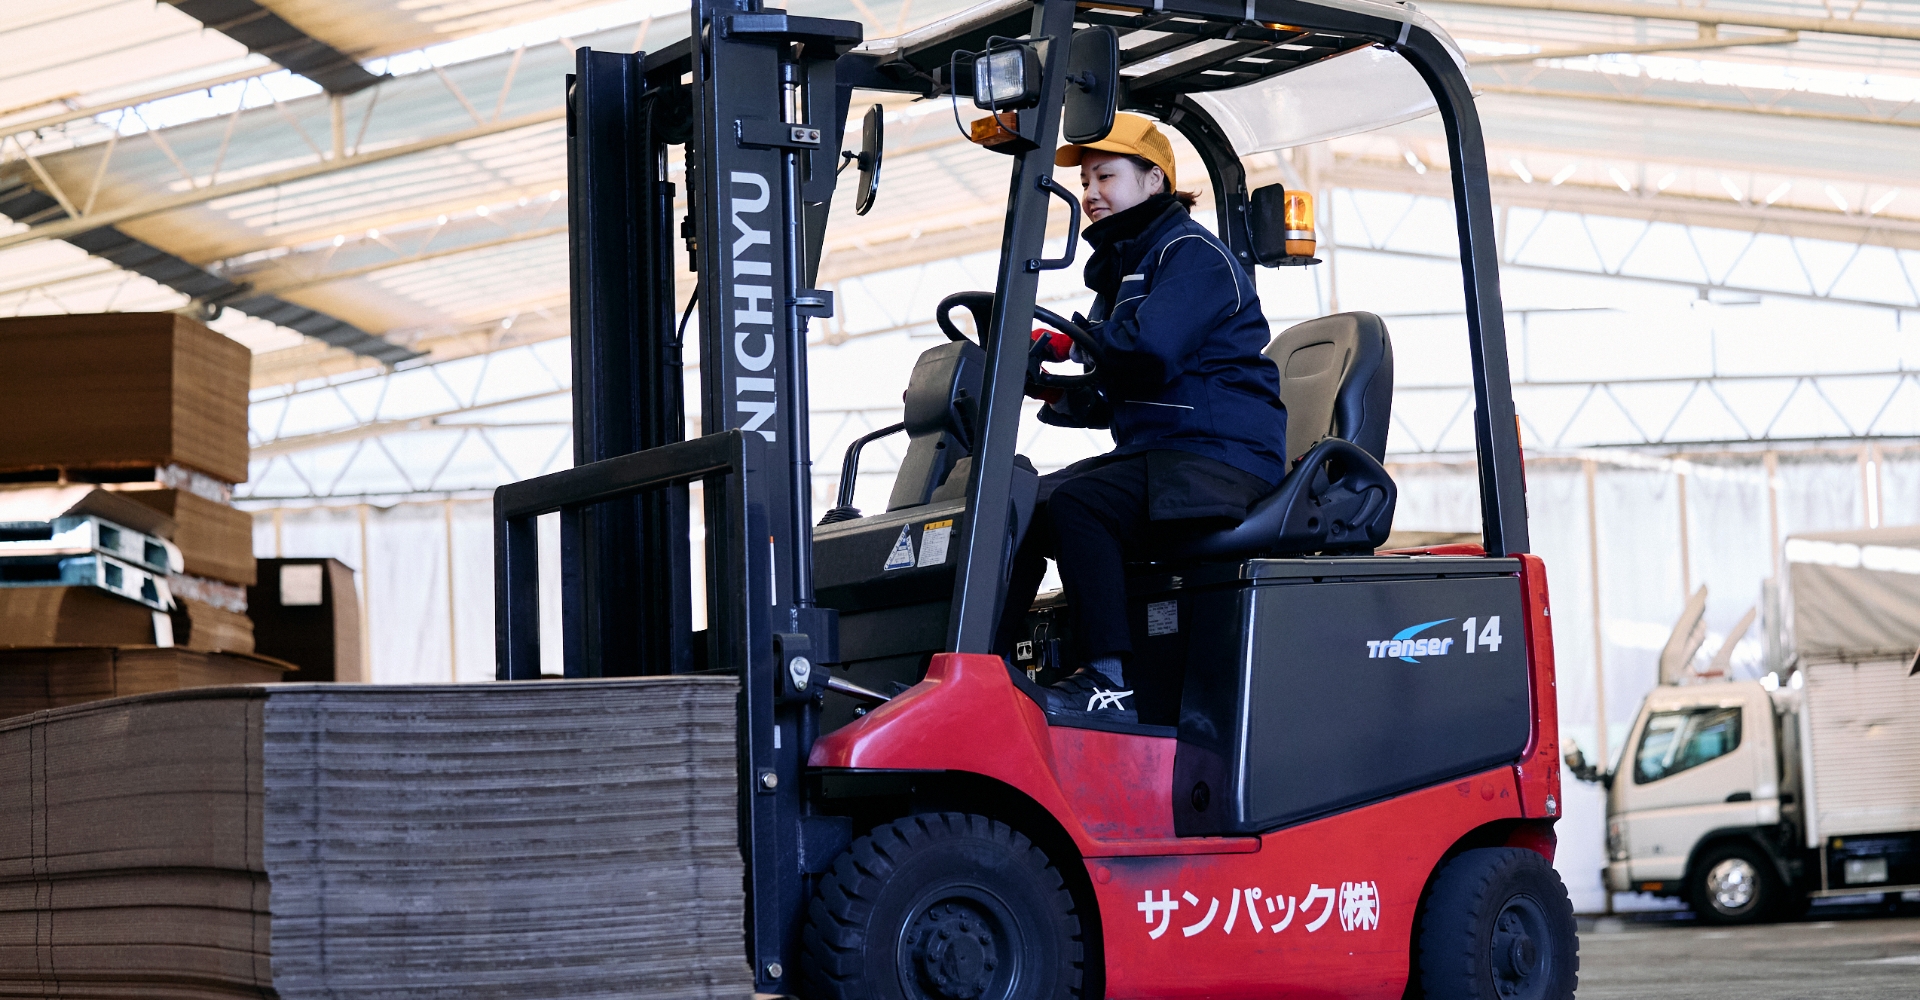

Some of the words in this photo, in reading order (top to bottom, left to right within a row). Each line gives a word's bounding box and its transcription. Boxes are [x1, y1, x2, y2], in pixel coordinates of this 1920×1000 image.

[730, 171, 776, 442] NICHIYU
[1366, 637, 1454, 658] Transer
[1462, 615, 1502, 653] 14
